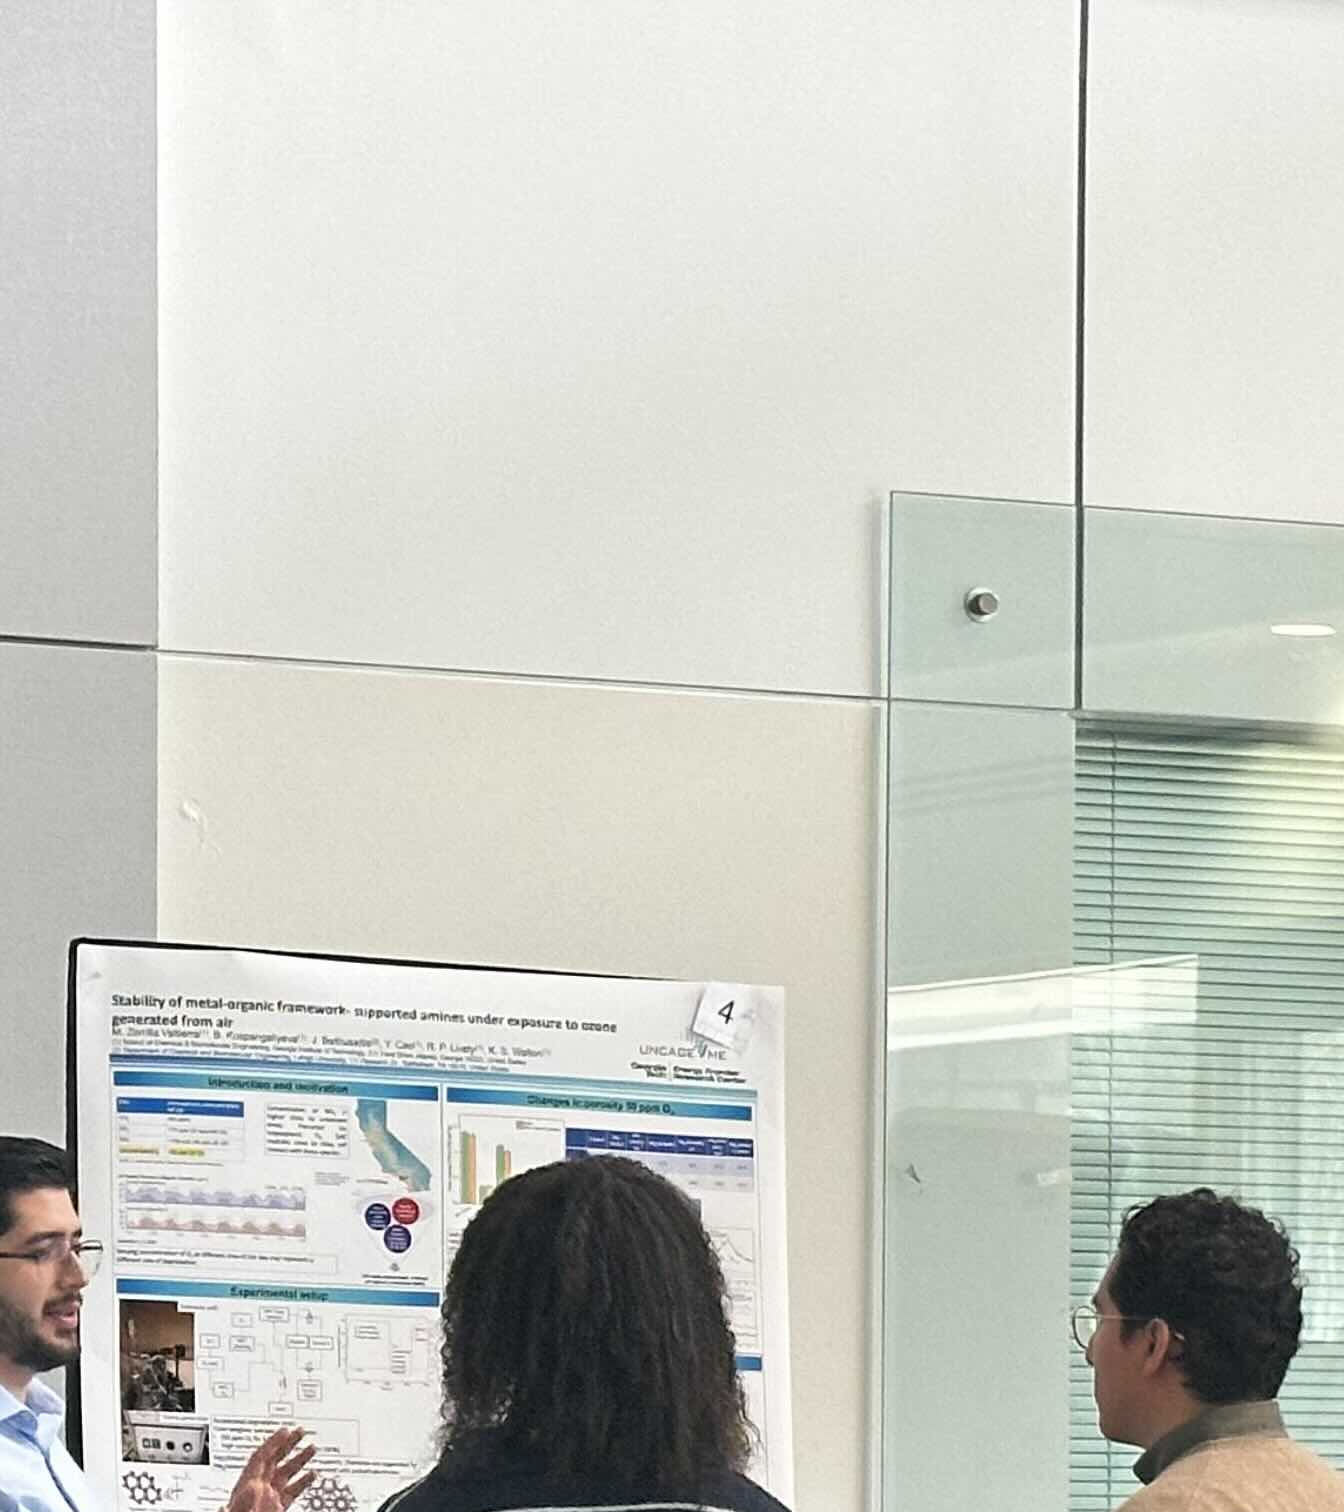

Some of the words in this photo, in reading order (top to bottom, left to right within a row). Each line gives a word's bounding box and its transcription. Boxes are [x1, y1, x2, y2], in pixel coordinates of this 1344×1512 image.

[111, 994, 165, 1009] Stability
[169, 995, 183, 1008] of
[186, 997, 275, 1013] metal-organic
[354, 1006, 417, 1021] supported
[420, 1010, 465, 1023] amines
[467, 1013, 504, 1026] under
[507, 1017, 562, 1031] exposure
[565, 1019, 578, 1030] to
[581, 1021, 617, 1033] ozone
[717, 1000, 735, 1024] 4
[111, 1014, 178, 1028] generated
[181, 1015, 213, 1027] from
[216, 1016, 233, 1028] air
[273, 1081, 293, 1091] and
[230, 1286, 298, 1300] Experimental
